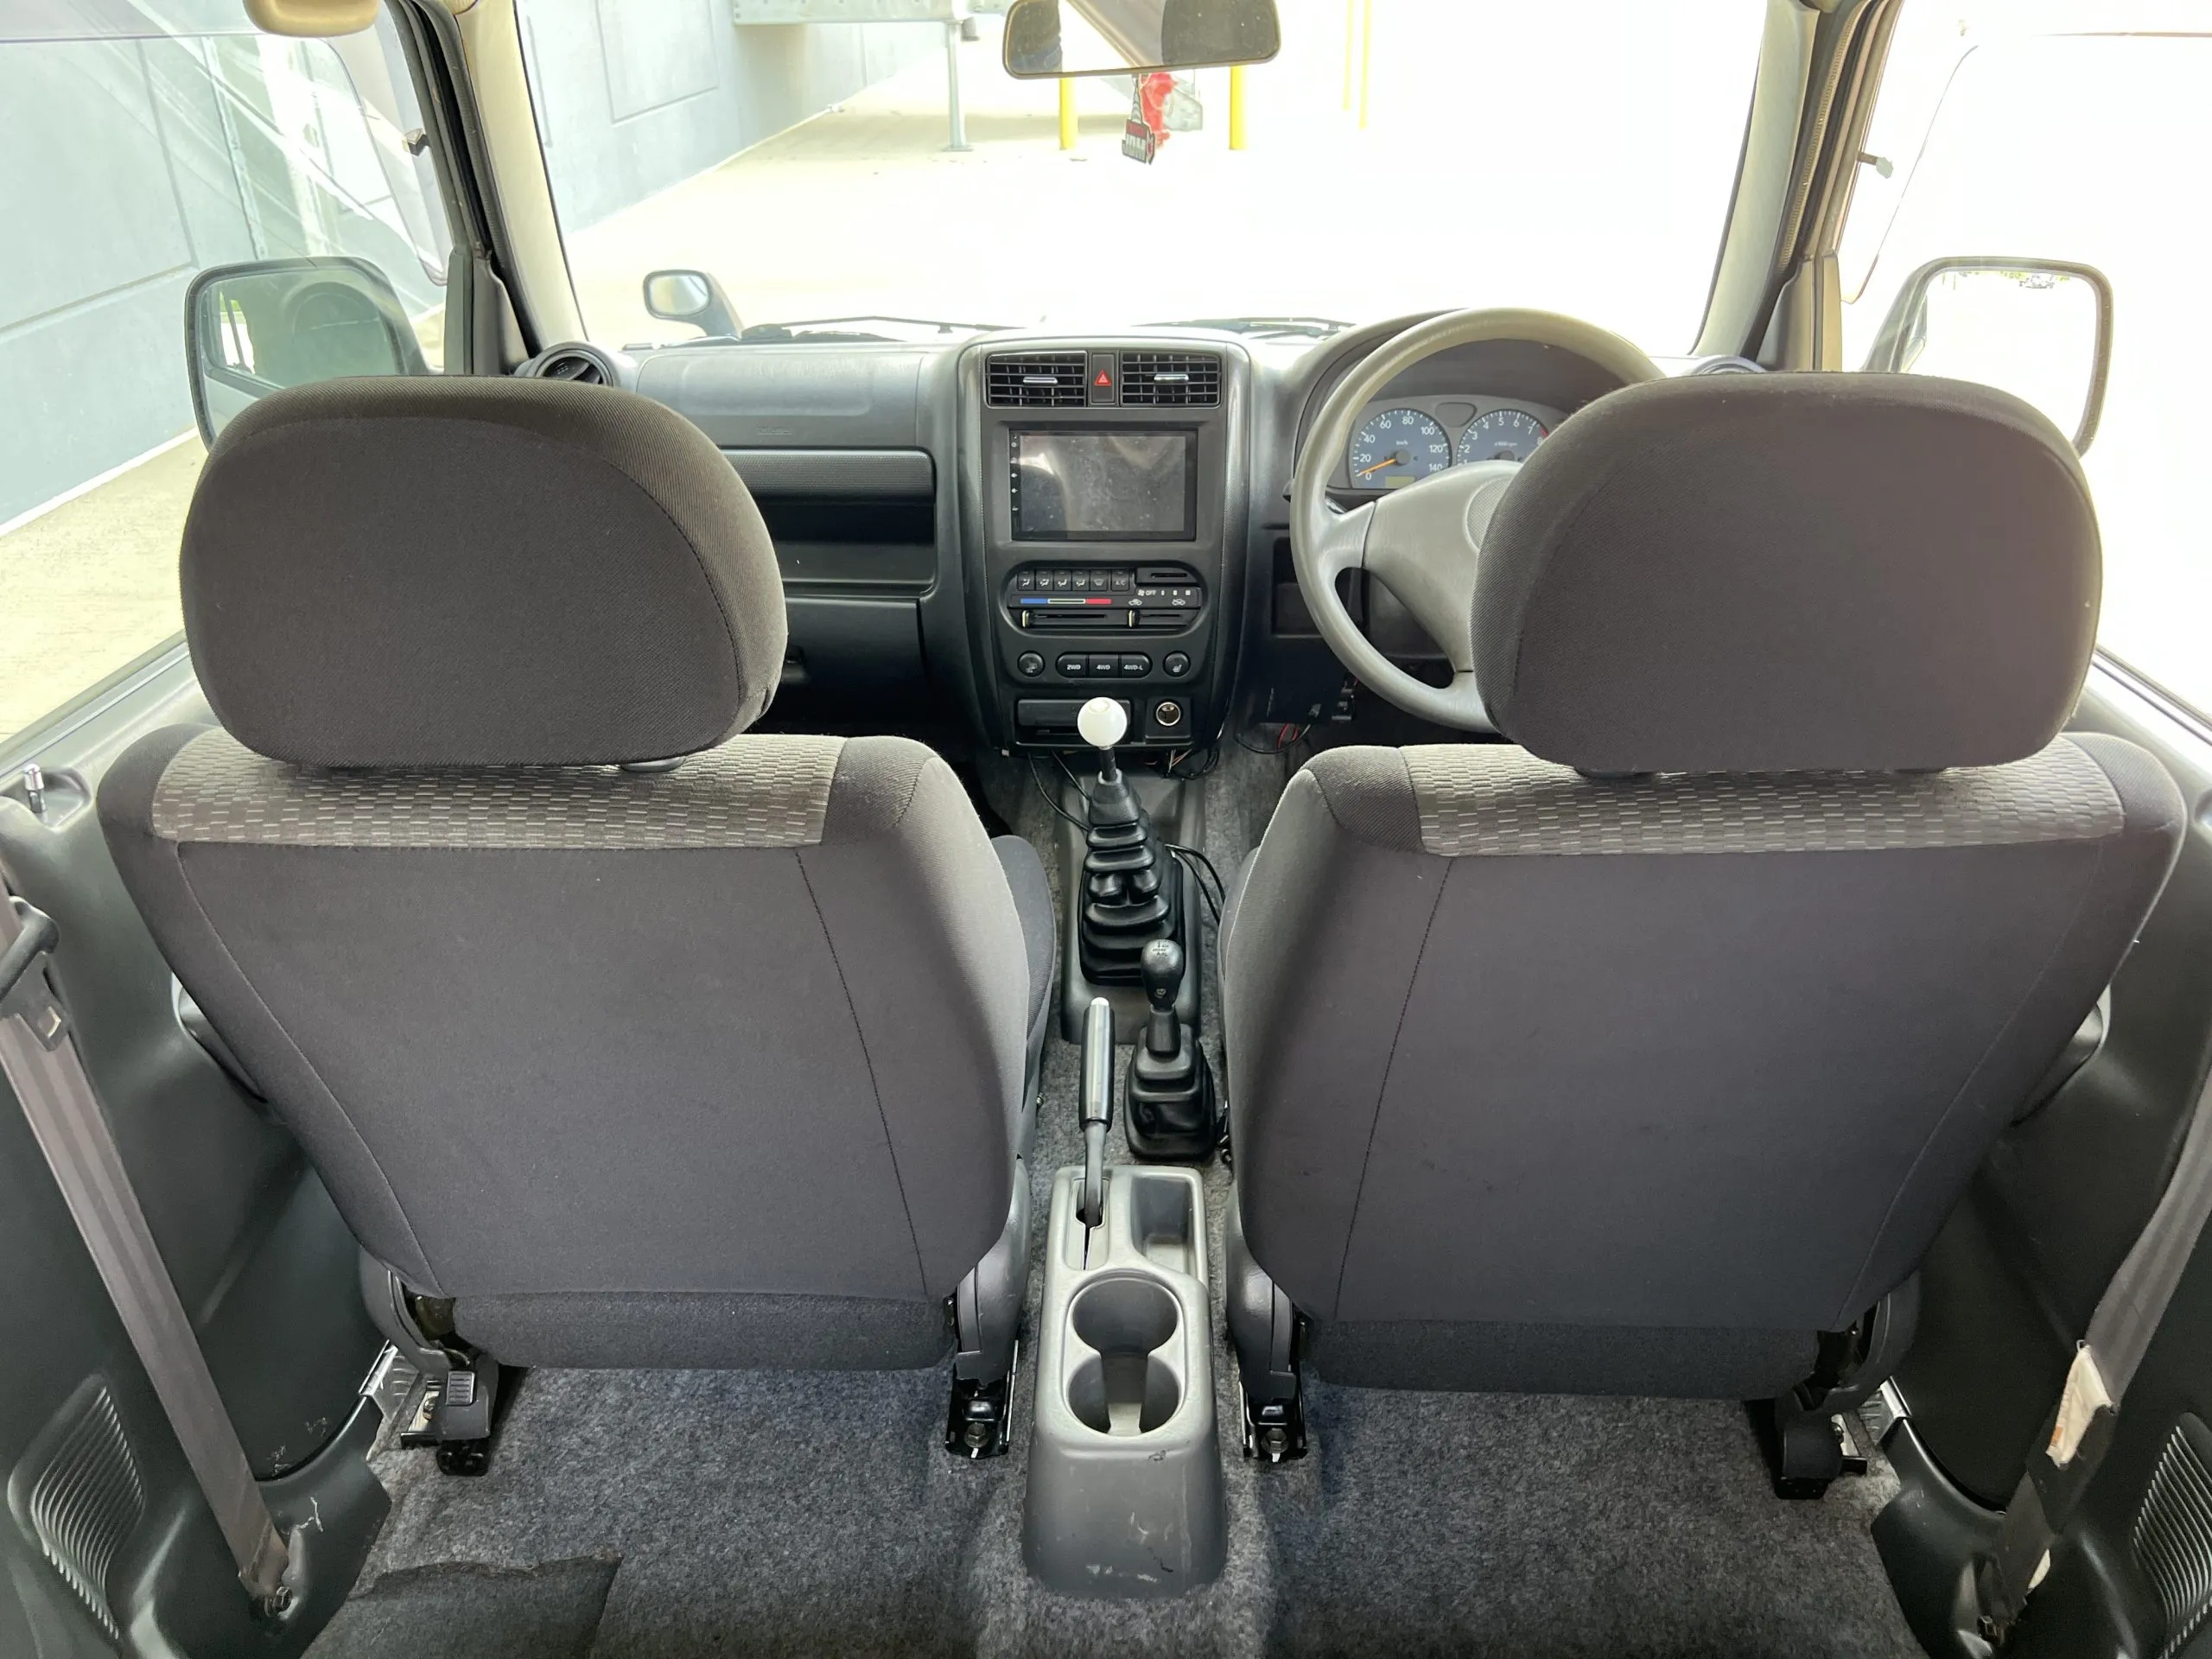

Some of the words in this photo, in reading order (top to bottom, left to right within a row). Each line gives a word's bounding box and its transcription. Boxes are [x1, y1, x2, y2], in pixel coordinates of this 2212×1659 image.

[1379, 420, 1391, 429] 60
[1402, 416, 1414, 425] 80
[1498, 417, 1504, 426] 5
[1513, 419, 1519, 427] 6
[1421, 426, 1435, 435] 100
[1528, 426, 1533, 435] 7
[1364, 435, 1376, 443] 40
[1472, 432, 1478, 440] 3
[1429, 445, 1443, 453] 120
[1464, 445, 1470, 453] 2
[1360, 454, 1371, 463] 20
[1429, 464, 1443, 472] 140
[1365, 472, 1372, 480] 0
